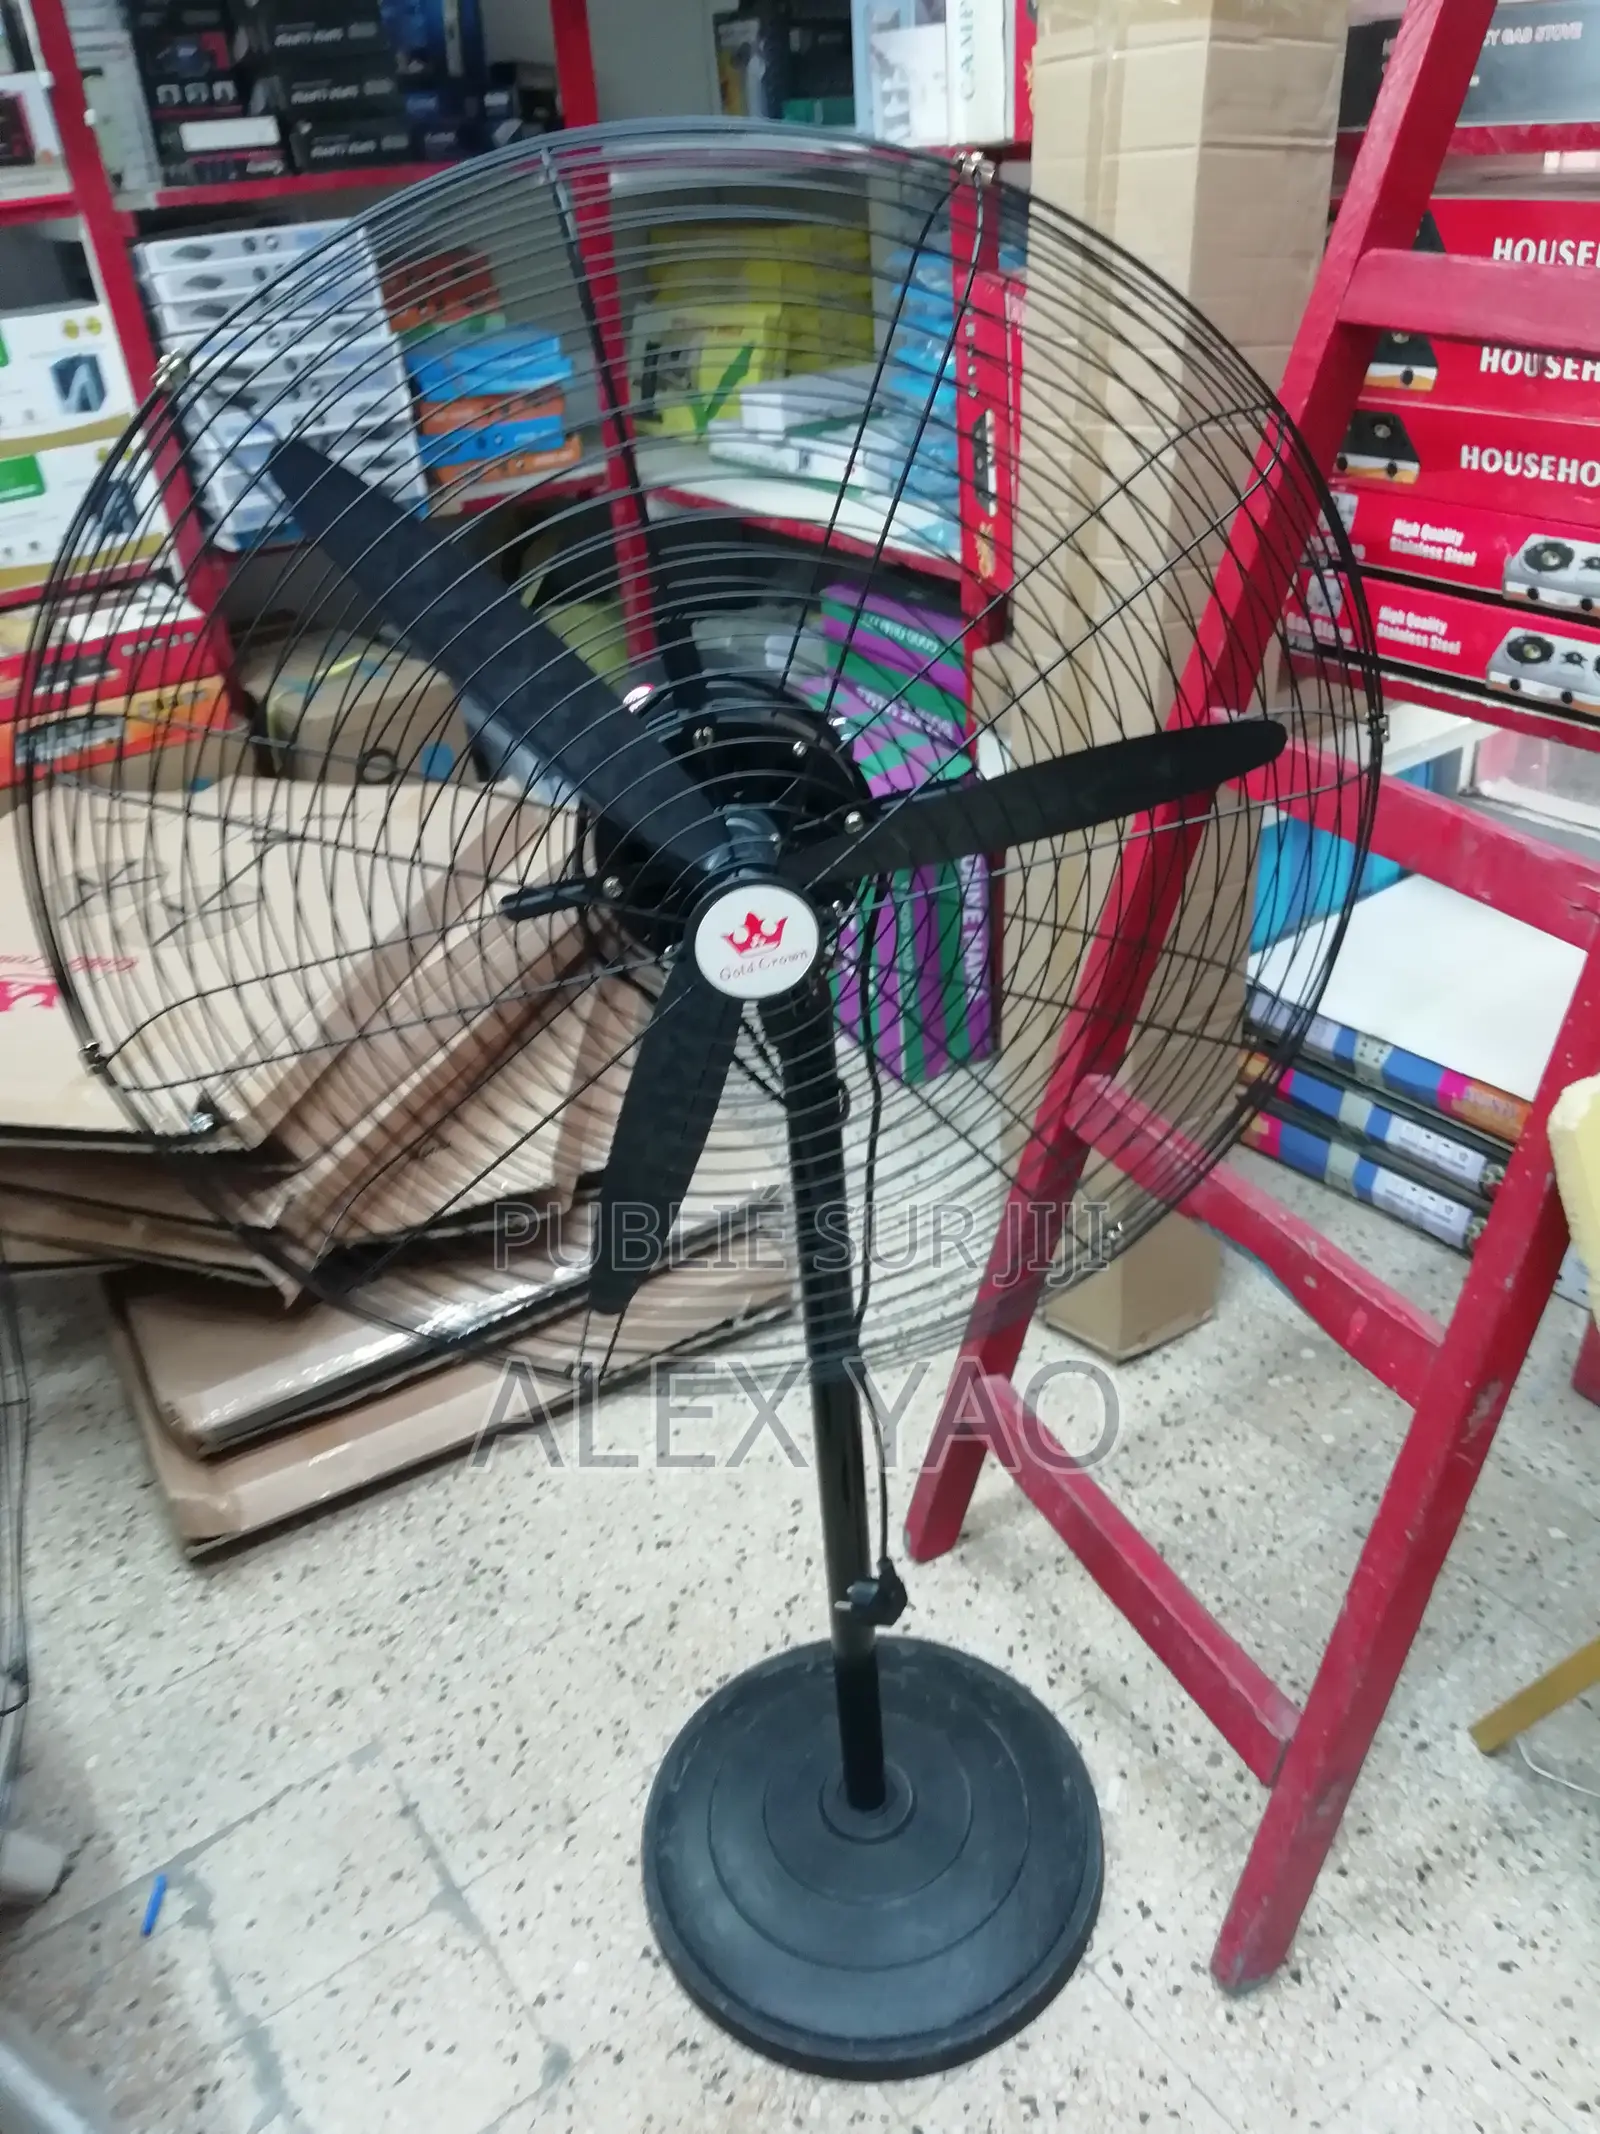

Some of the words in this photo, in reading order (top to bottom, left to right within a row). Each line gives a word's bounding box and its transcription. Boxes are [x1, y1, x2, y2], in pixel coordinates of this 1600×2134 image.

[1534, 21, 1584, 43] STOVE
[1492, 237, 1600, 269] HOUSE
[1460, 444, 1600, 488] HOUSEHO
[1392, 518, 1420, 539] High
[1420, 523, 1465, 548] Quality
[1389, 536, 1444, 561] Stainless
[1444, 546, 1477, 568] Steel
[1378, 605, 1405, 625] High
[1406, 612, 1448, 637] Quality
[1376, 622, 1429, 649] Stainless
[1429, 634, 1462, 656] Steel
[719, 961, 755, 982] Gold
[757, 949, 809, 970] Crown
